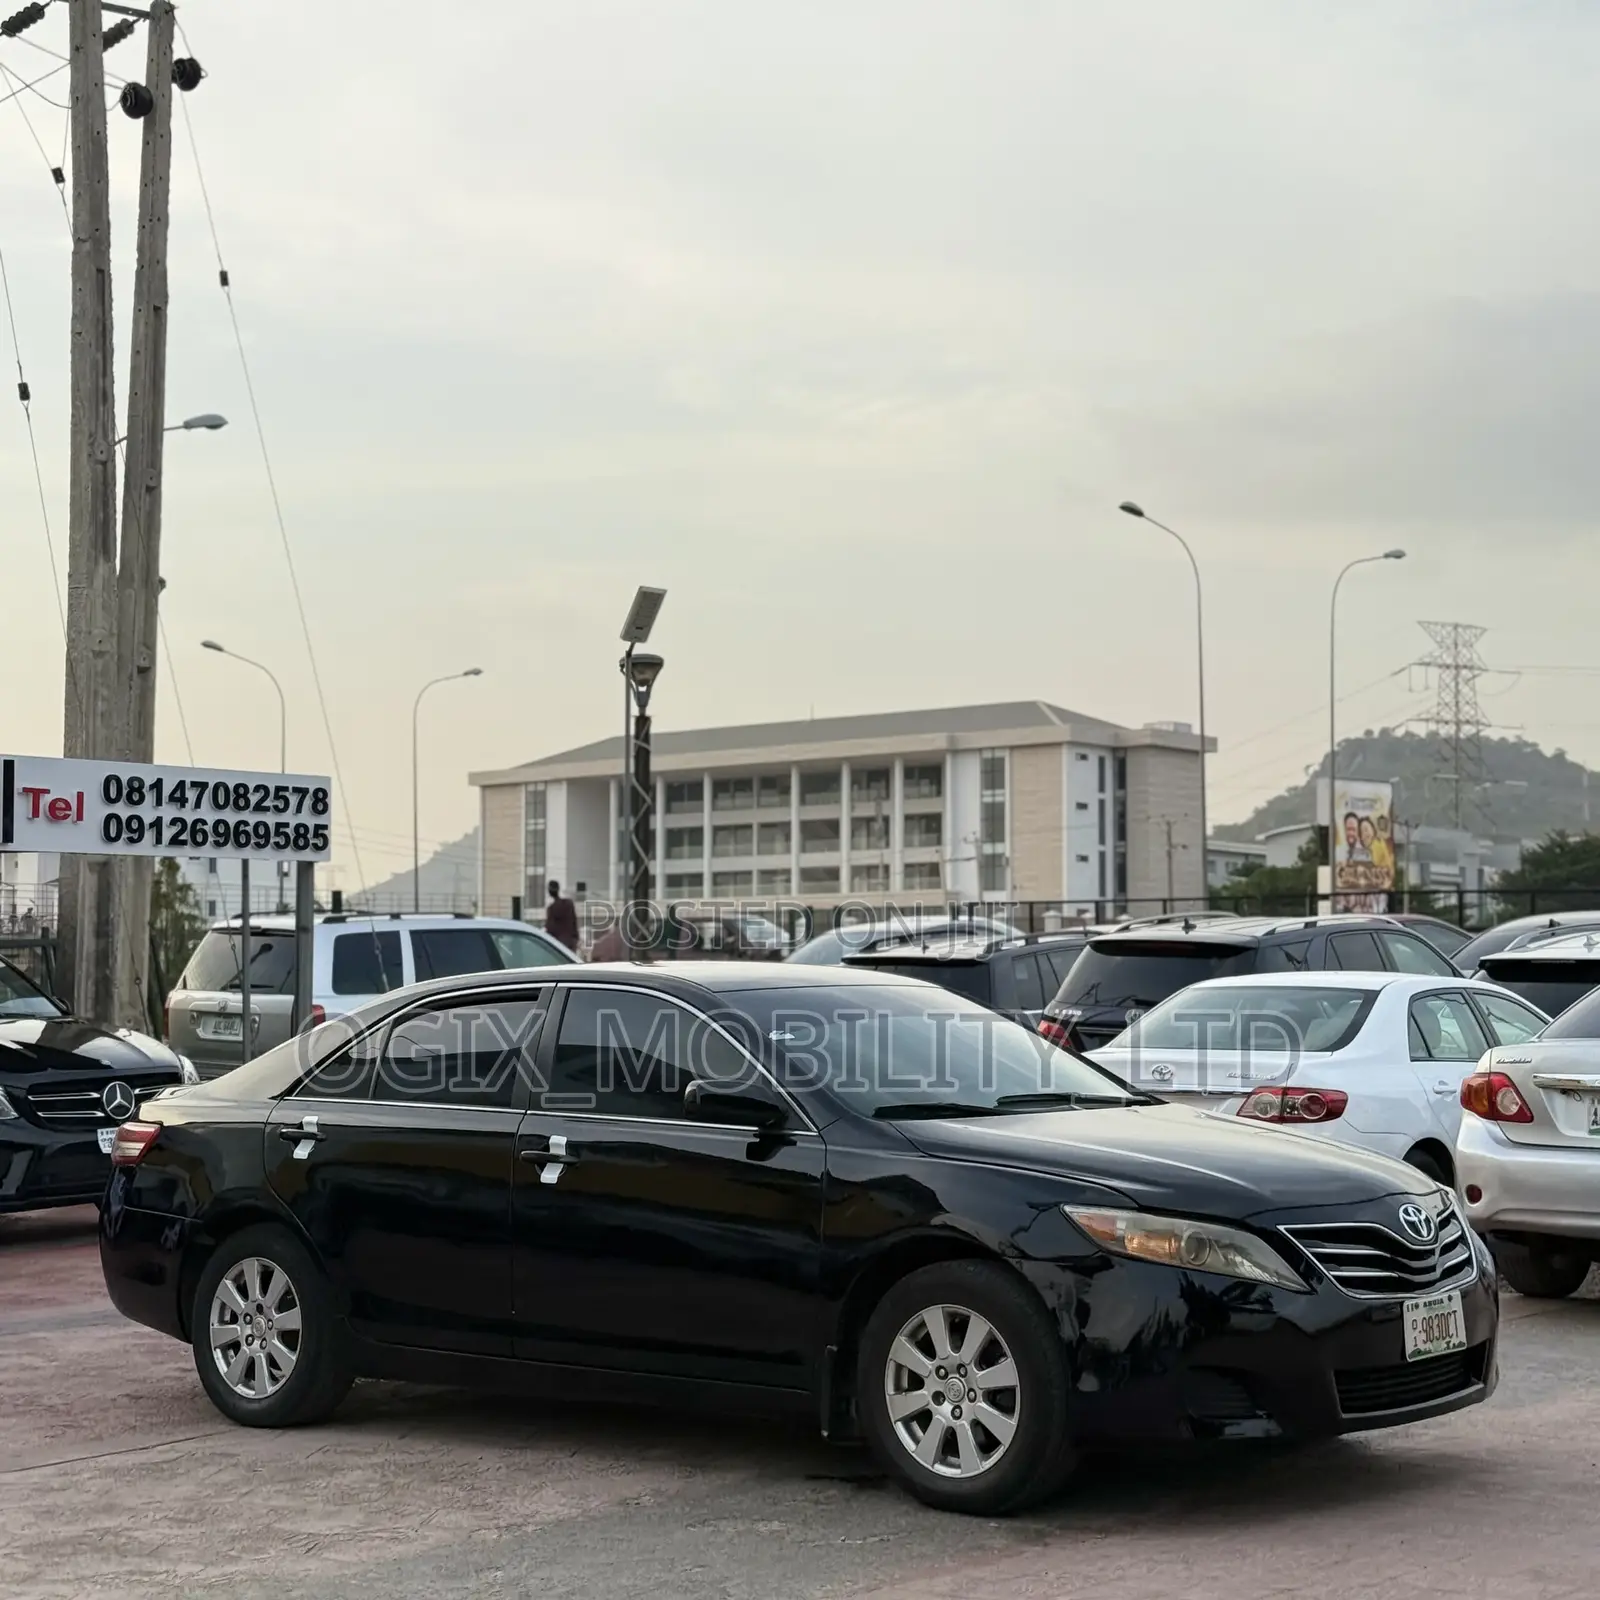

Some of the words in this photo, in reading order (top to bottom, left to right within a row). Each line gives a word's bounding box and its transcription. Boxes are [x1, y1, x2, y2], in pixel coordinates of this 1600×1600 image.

[20, 786, 85, 823] Tel
[101, 773, 330, 816] 08147082578
[101, 812, 330, 851] 09126969585
